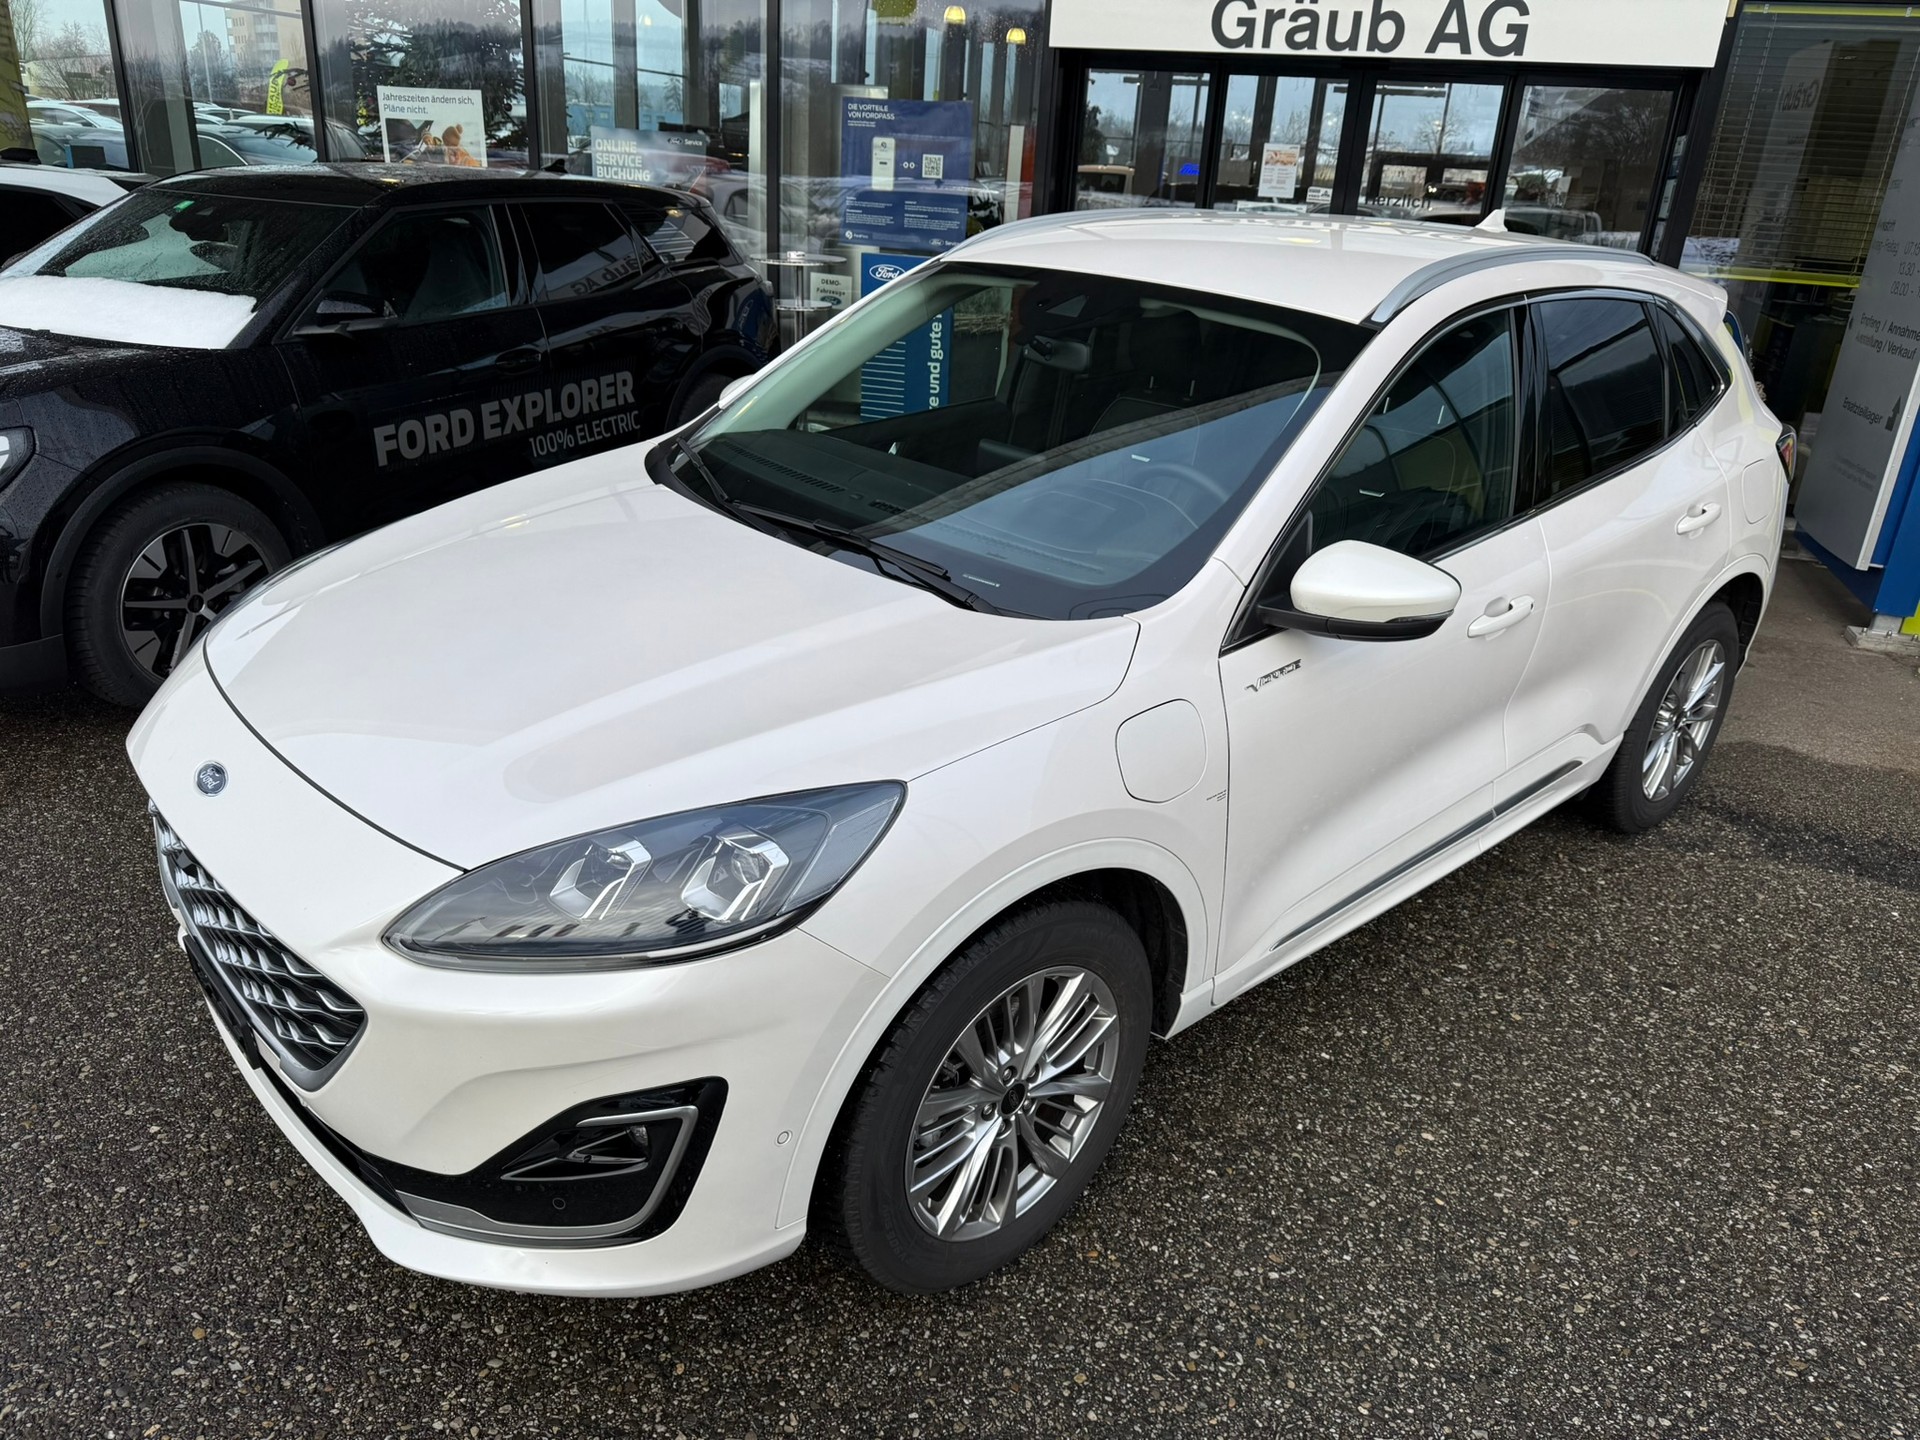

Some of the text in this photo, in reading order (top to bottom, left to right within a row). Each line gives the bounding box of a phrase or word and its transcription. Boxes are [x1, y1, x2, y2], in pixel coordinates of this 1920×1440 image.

[1211, 0, 1530, 57] Gräub AG
[382, 92, 475, 106] Jahreszeiten ändern sich,
[383, 104, 429, 115] Pläne nicht.
[859, 104, 888, 112] VORTEILE
[862, 112, 895, 120] FORDPASS
[595, 139, 637, 154] ONLINE
[684, 139, 703, 147] Service
[595, 153, 643, 168] SERVICE
[596, 167, 651, 182] BUCHUNG
[1365, 194, 1431, 209] Herzlich
[875, 265, 900, 280] Ford
[1887, 321, 1920, 342] Annahme
[929, 321, 944, 360] gute
[1887, 341, 1918, 360] Verkauf
[927, 362, 941, 394] und
[373, 370, 636, 467] FORD EXPLORER
[528, 410, 641, 458] 100% ELECTRIC
